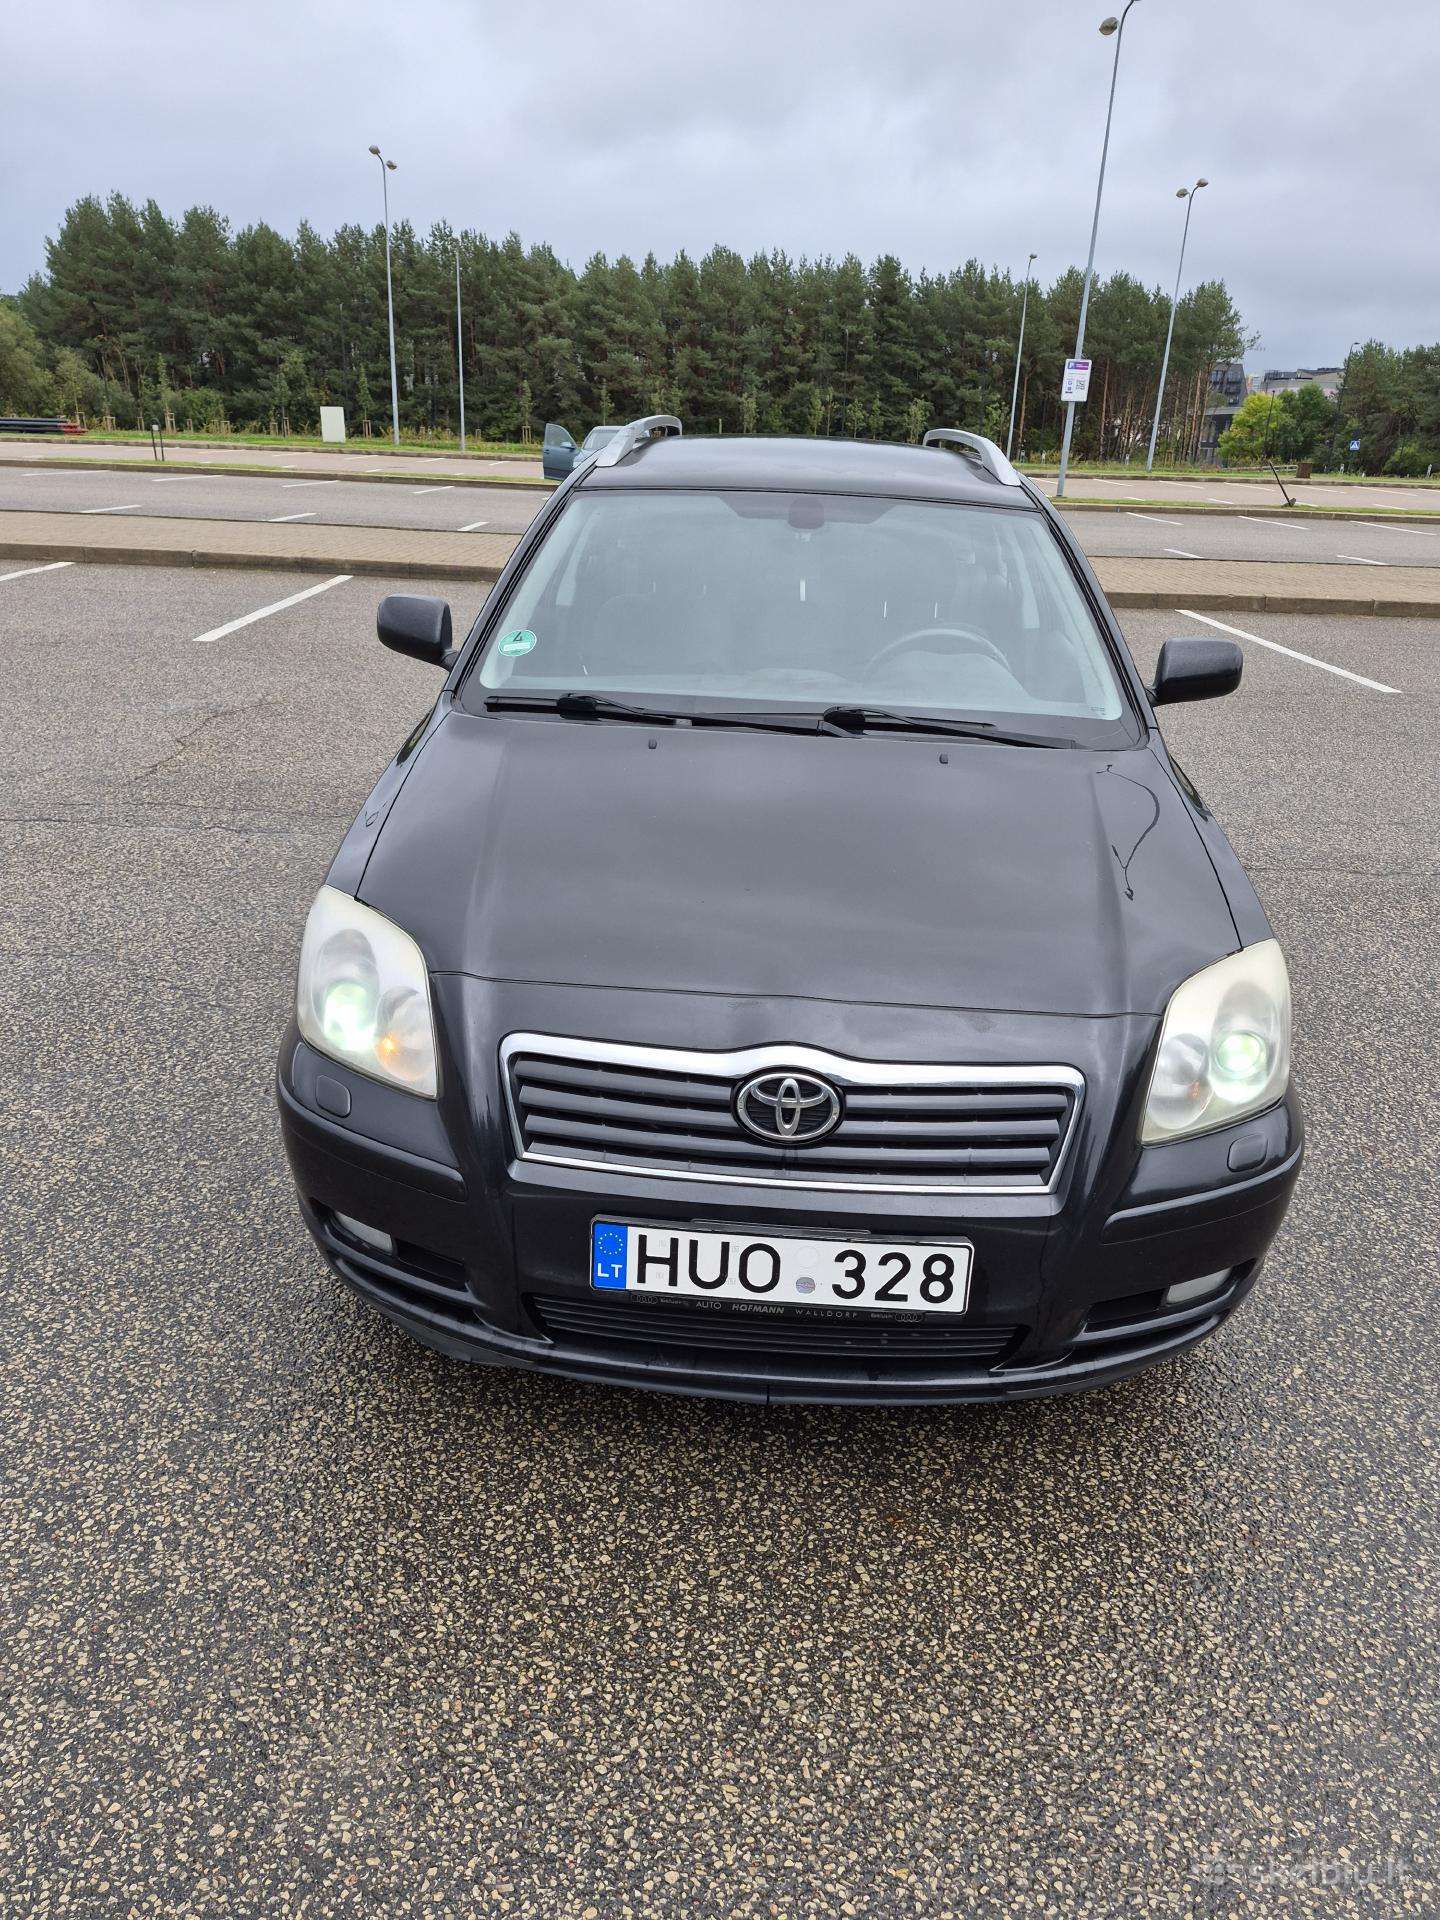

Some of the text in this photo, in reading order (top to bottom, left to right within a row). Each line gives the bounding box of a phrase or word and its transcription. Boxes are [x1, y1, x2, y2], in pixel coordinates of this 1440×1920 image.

[597, 1263, 623, 1279] LT
[636, 1234, 955, 1304] HUO 328
[695, 1300, 722, 1310] AUTO
[731, 1303, 785, 1315] HOFMANN
[795, 1308, 859, 1319] WALLDORF
